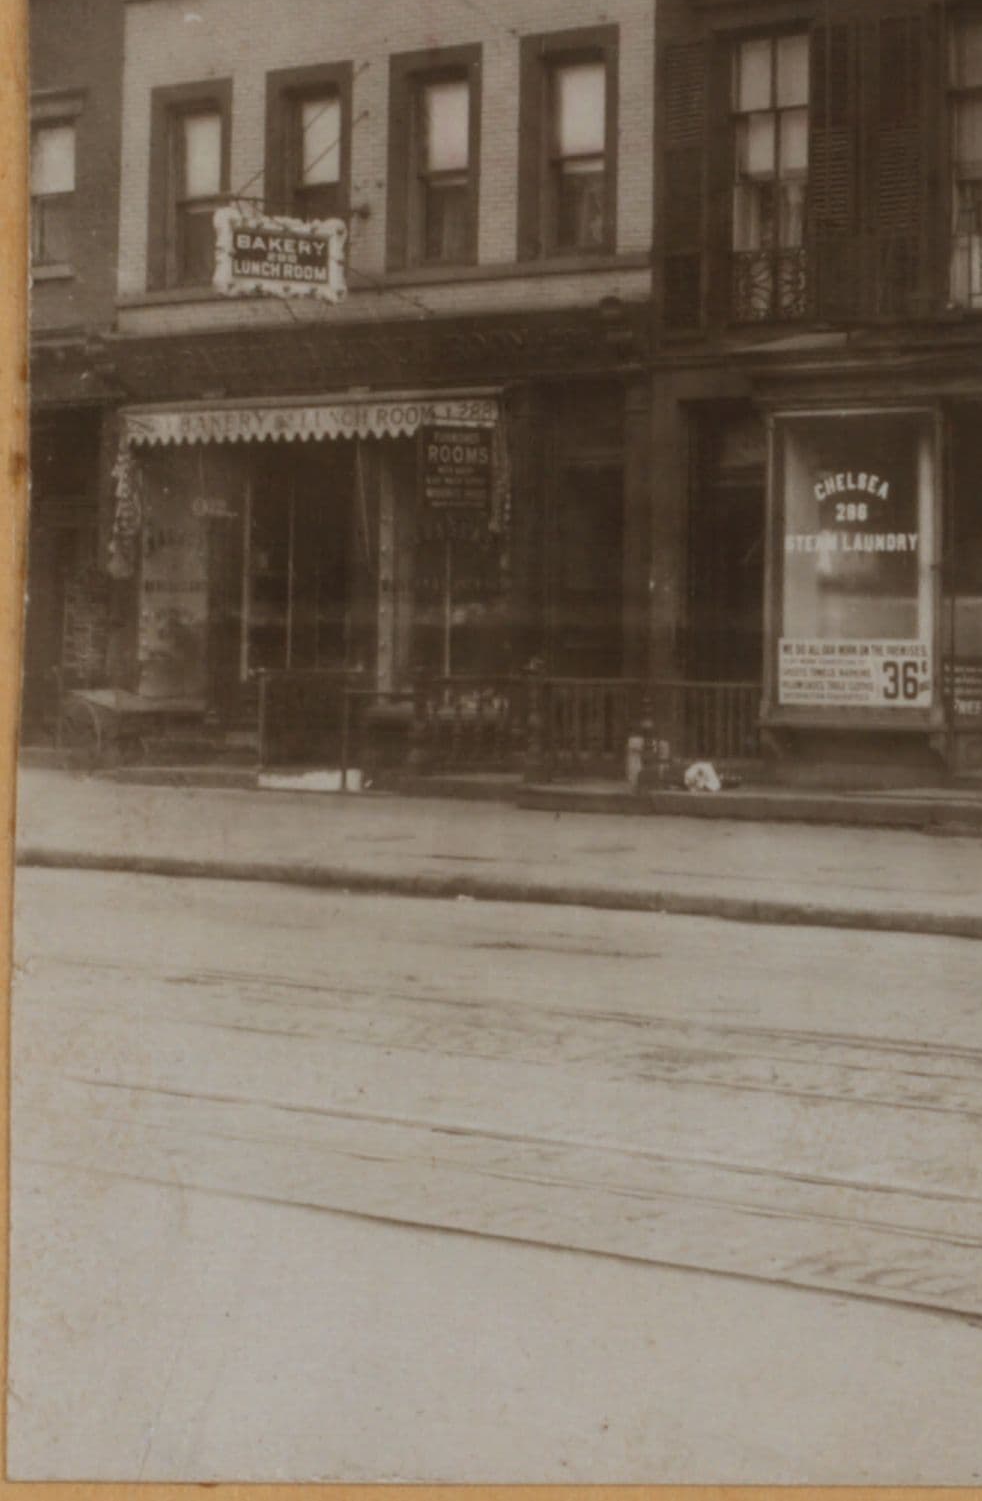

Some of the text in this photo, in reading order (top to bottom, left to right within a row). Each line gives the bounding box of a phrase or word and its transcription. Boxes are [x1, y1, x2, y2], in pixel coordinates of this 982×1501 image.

[236, 234, 325, 256] BAKERY
[234, 260, 327, 281] LUNCH ROOM
[180, 409, 267, 436] BAKERY
[301, 406, 368, 431] LUNCH
[427, 444, 489, 464] ROOMS
[813, 471, 890, 501] CHELSEA
[784, 531, 919, 552] STEAM LAUNDRY
